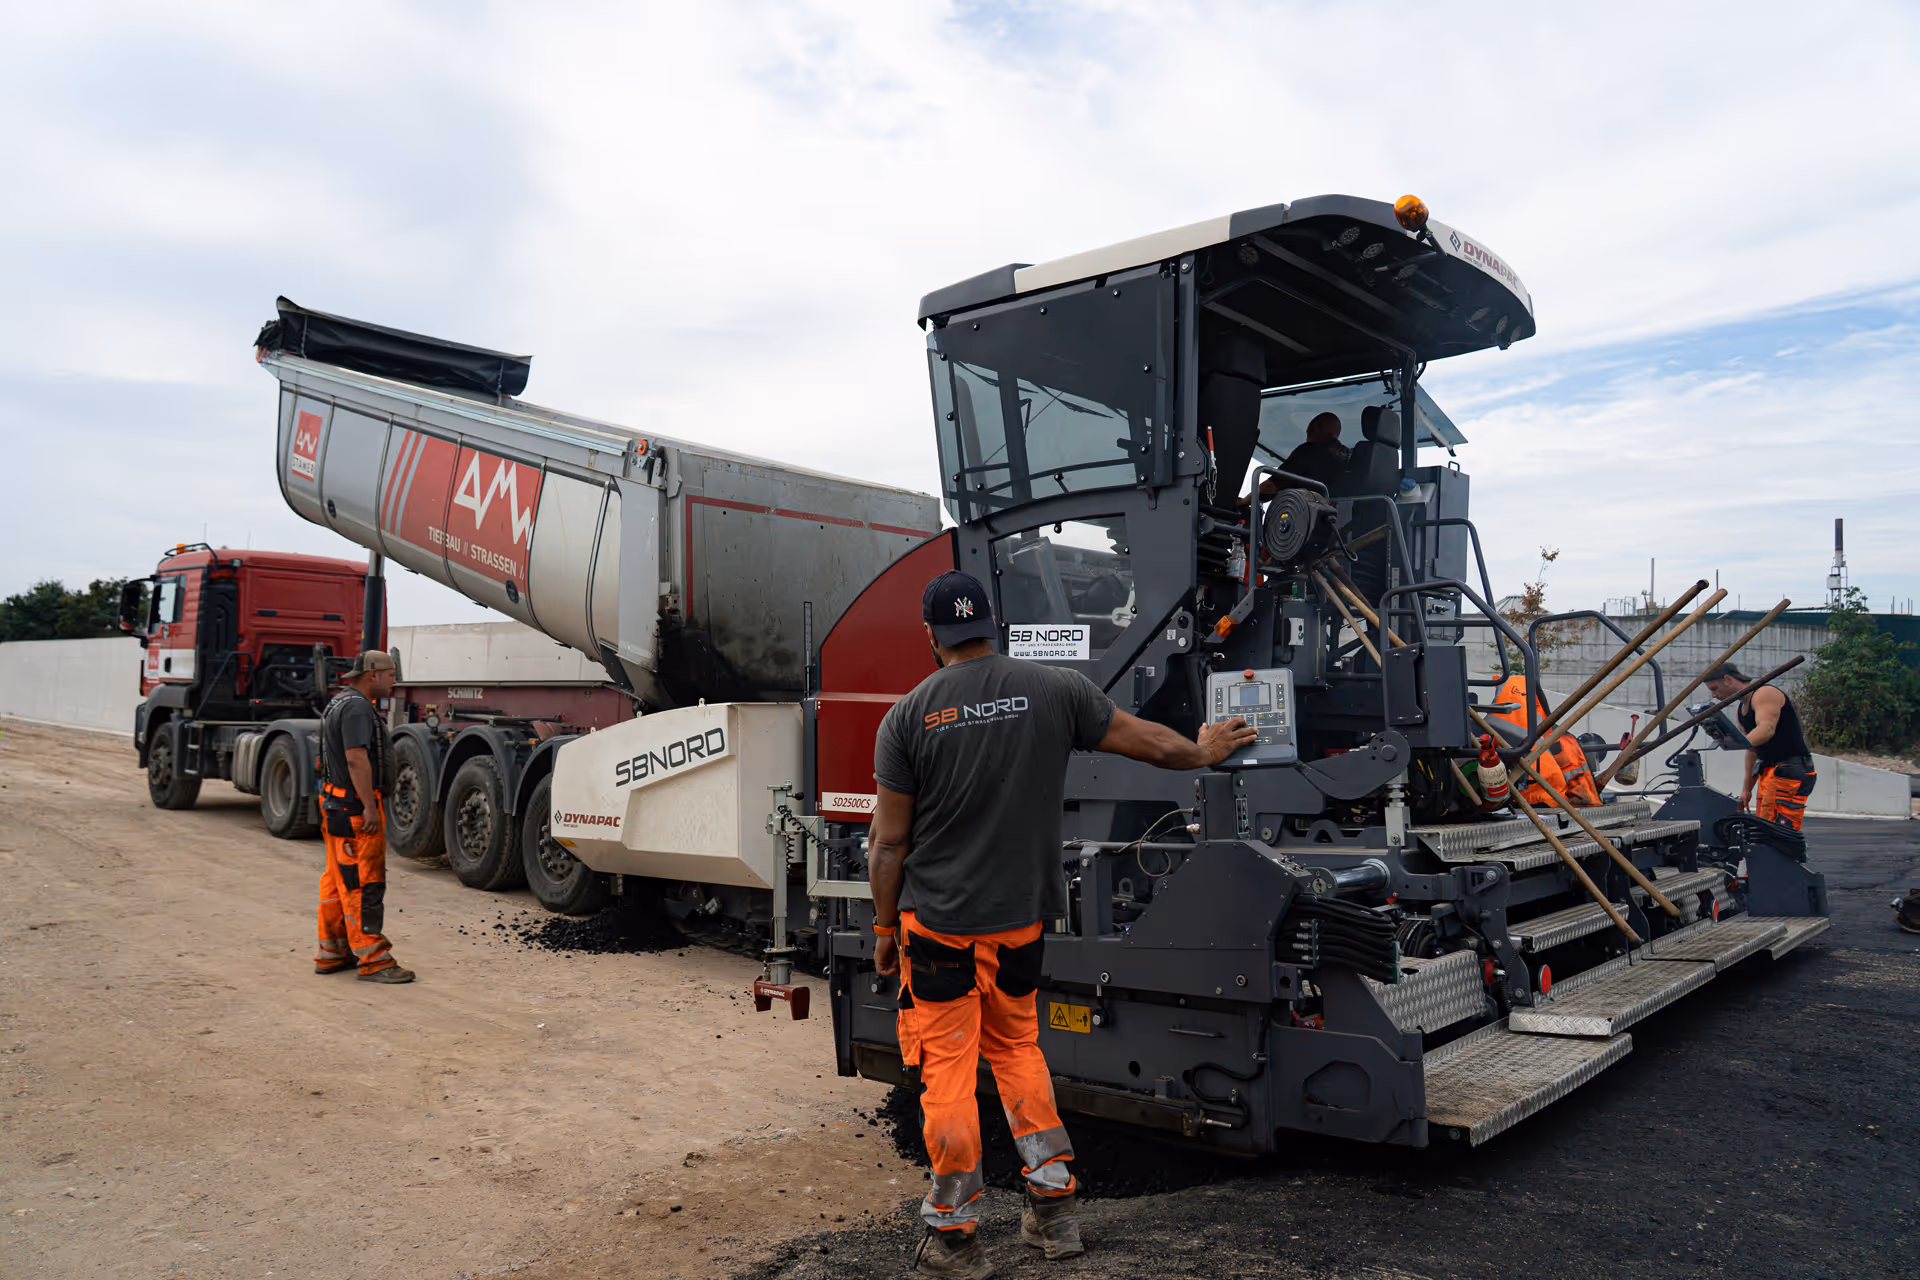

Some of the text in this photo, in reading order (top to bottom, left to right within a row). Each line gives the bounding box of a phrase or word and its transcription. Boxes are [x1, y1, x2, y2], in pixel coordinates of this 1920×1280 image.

[1463, 240, 1518, 290] DYNAPAC
[428, 526, 461, 552] TIEFBAU
[470, 544, 517, 577] STRASSEN
[1009, 629, 1084, 642] SB NORD
[447, 687, 484, 699] SCHMITZ
[924, 696, 1028, 730] SB NORD
[832, 797, 872, 809] SD2500CS
[563, 813, 621, 828] DYNAPAC
